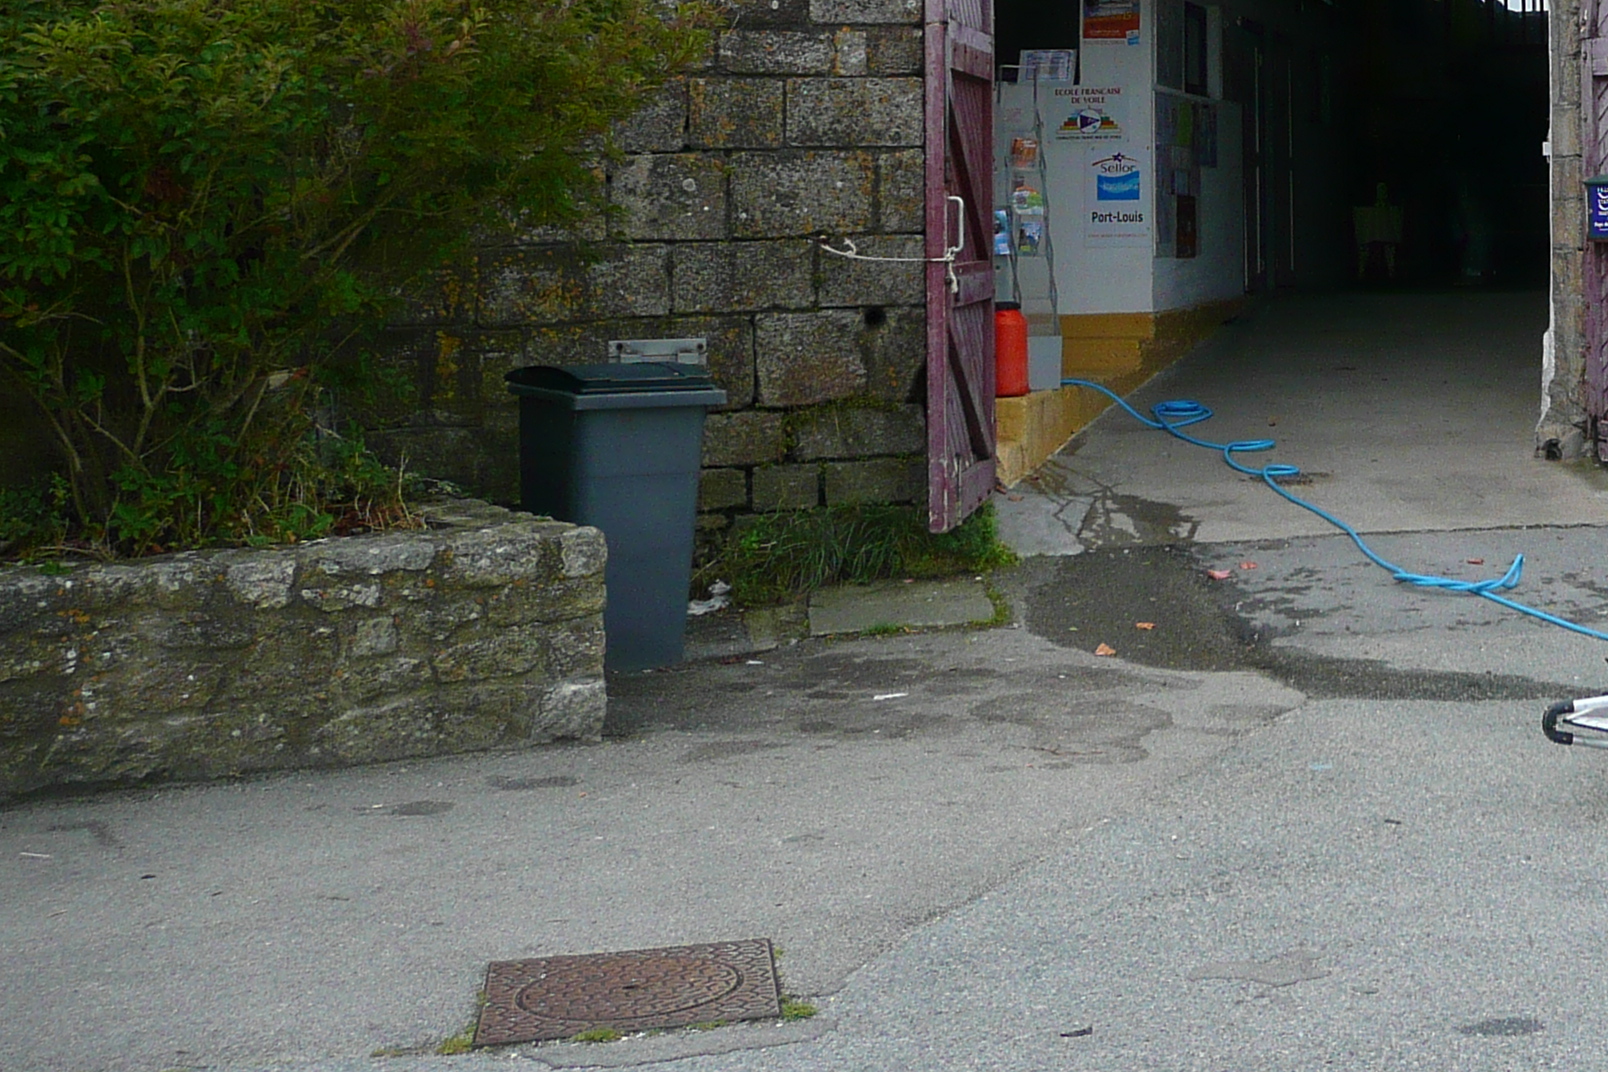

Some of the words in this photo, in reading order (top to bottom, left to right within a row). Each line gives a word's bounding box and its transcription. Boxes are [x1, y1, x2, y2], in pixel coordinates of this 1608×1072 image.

[1083, 96, 1107, 104] VOILE
[1100, 161, 1136, 173] Sellor
[1091, 210, 1144, 223] Port-Louis
